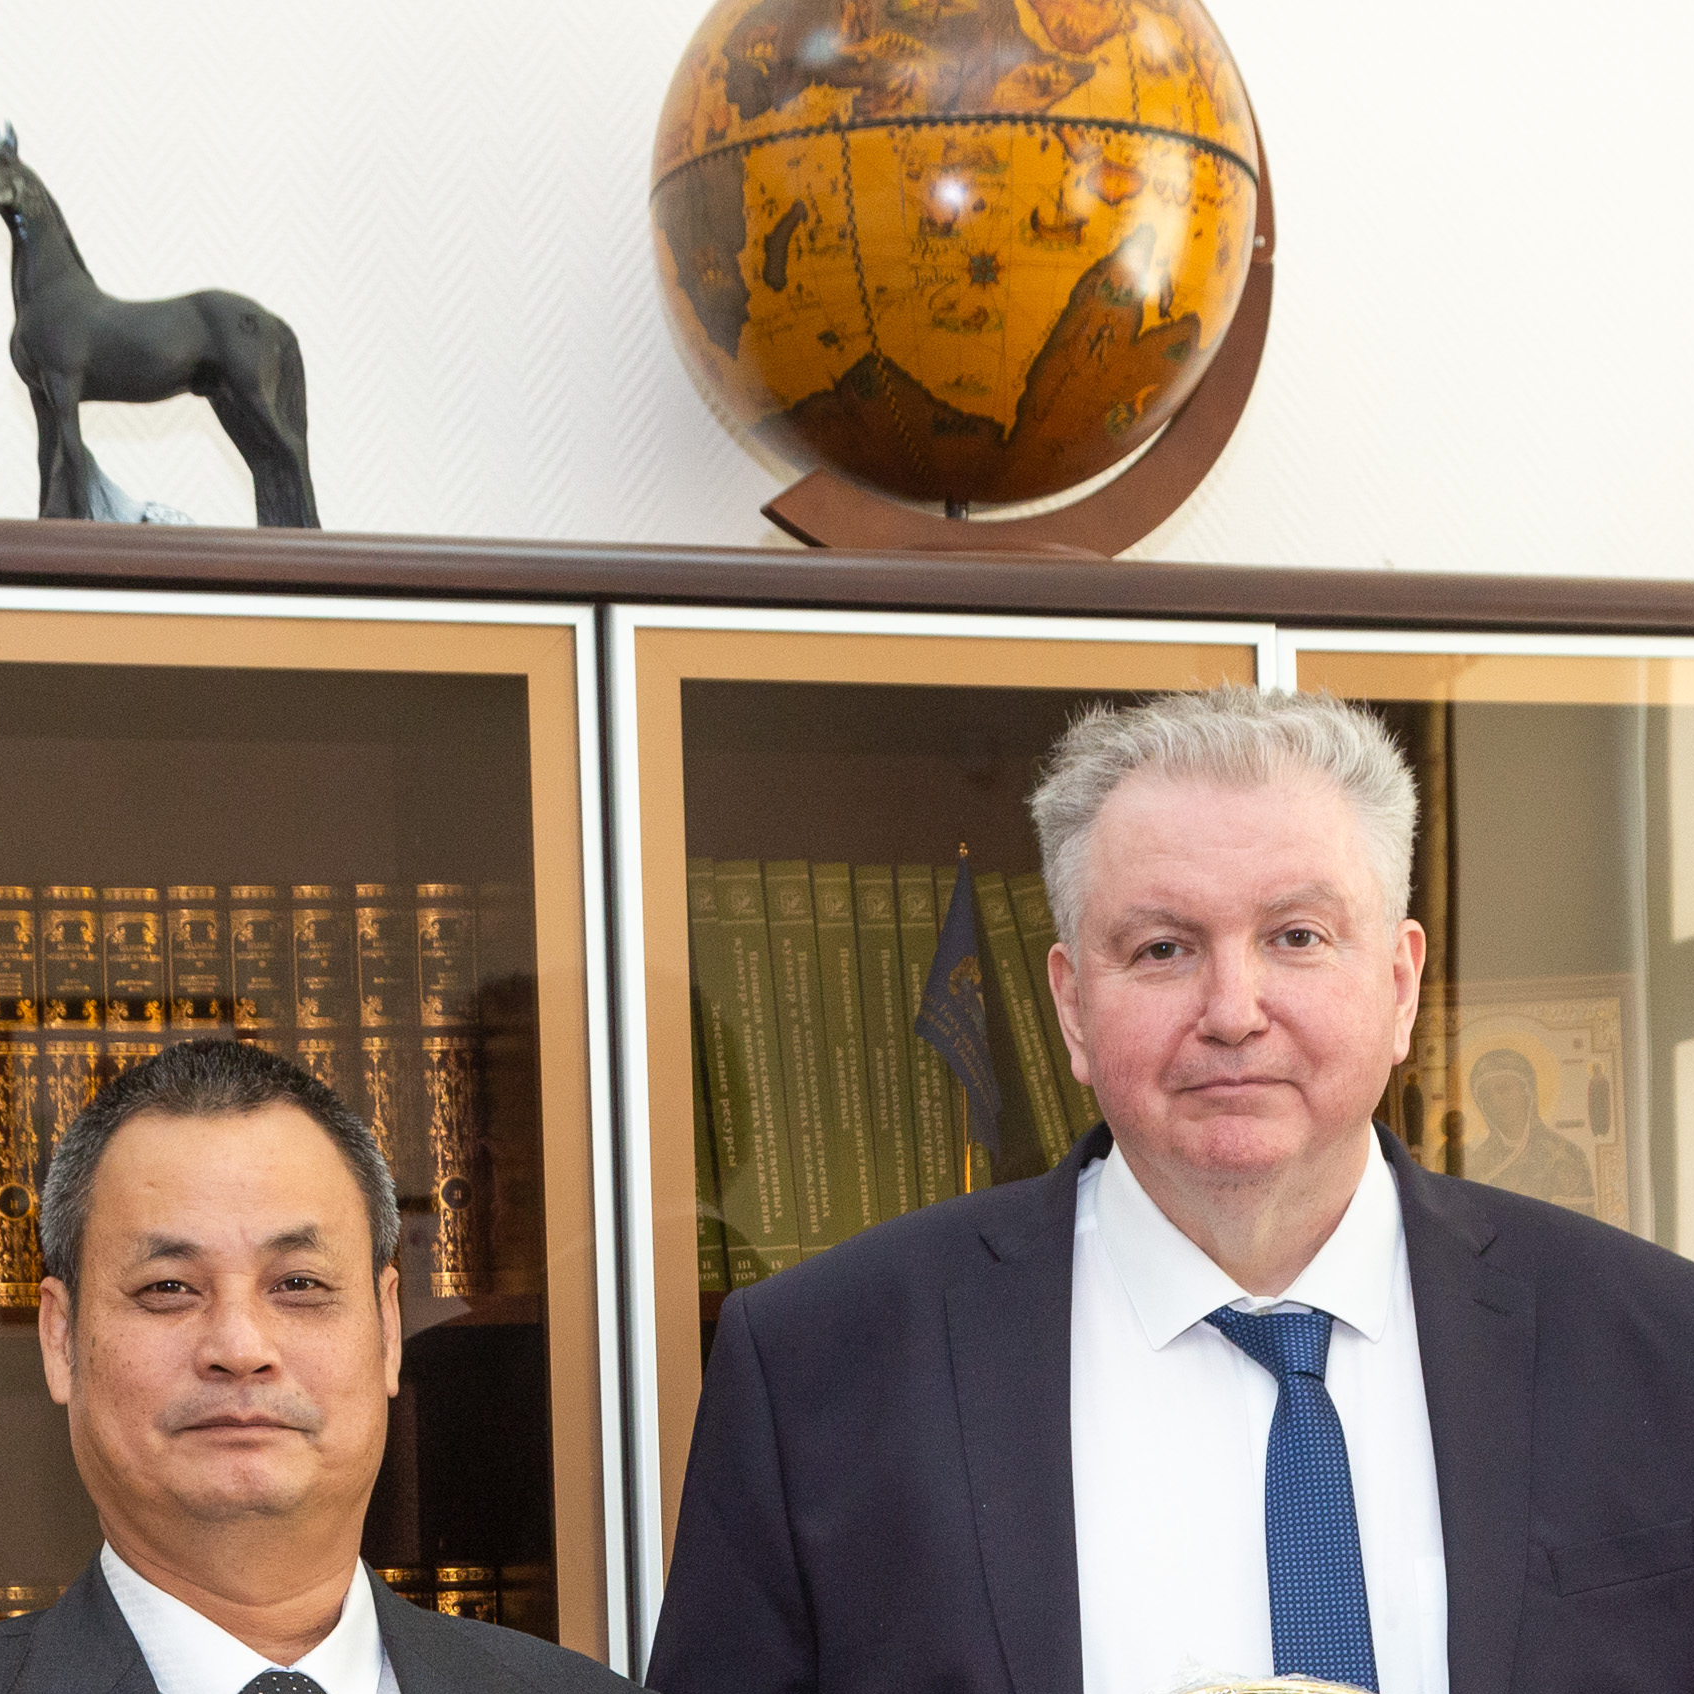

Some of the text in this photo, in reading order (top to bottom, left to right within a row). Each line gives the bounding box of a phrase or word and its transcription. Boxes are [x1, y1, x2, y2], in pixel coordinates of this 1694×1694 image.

[879, 948, 896, 1034] Поголовье
[710, 1000, 739, 1169] Земельные ресурсы
[733, 936, 750, 1003] культур
[743, 1022, 762, 1128] многолетних
[753, 1133, 774, 1235] насаждений
[747, 950, 784, 1220] Площади сельскохозяйственных
[782, 937, 799, 1003] культур
[791, 1023, 811, 1128] многолетних
[802, 1133, 822, 1235] насаждений
[796, 950, 832, 1219] Площади сельскохозяйственных
[835, 1046, 850, 1131] животных
[838, 947, 872, 1227] Поголовье сельскохозяйственных
[874, 1046, 890, 1132] животных
[918, 1076, 938, 1205] инфраструктур
[733, 1271, 758, 1282] ТОМ
[737, 1259, 752, 1270] III
[770, 1259, 784, 1270] IV
